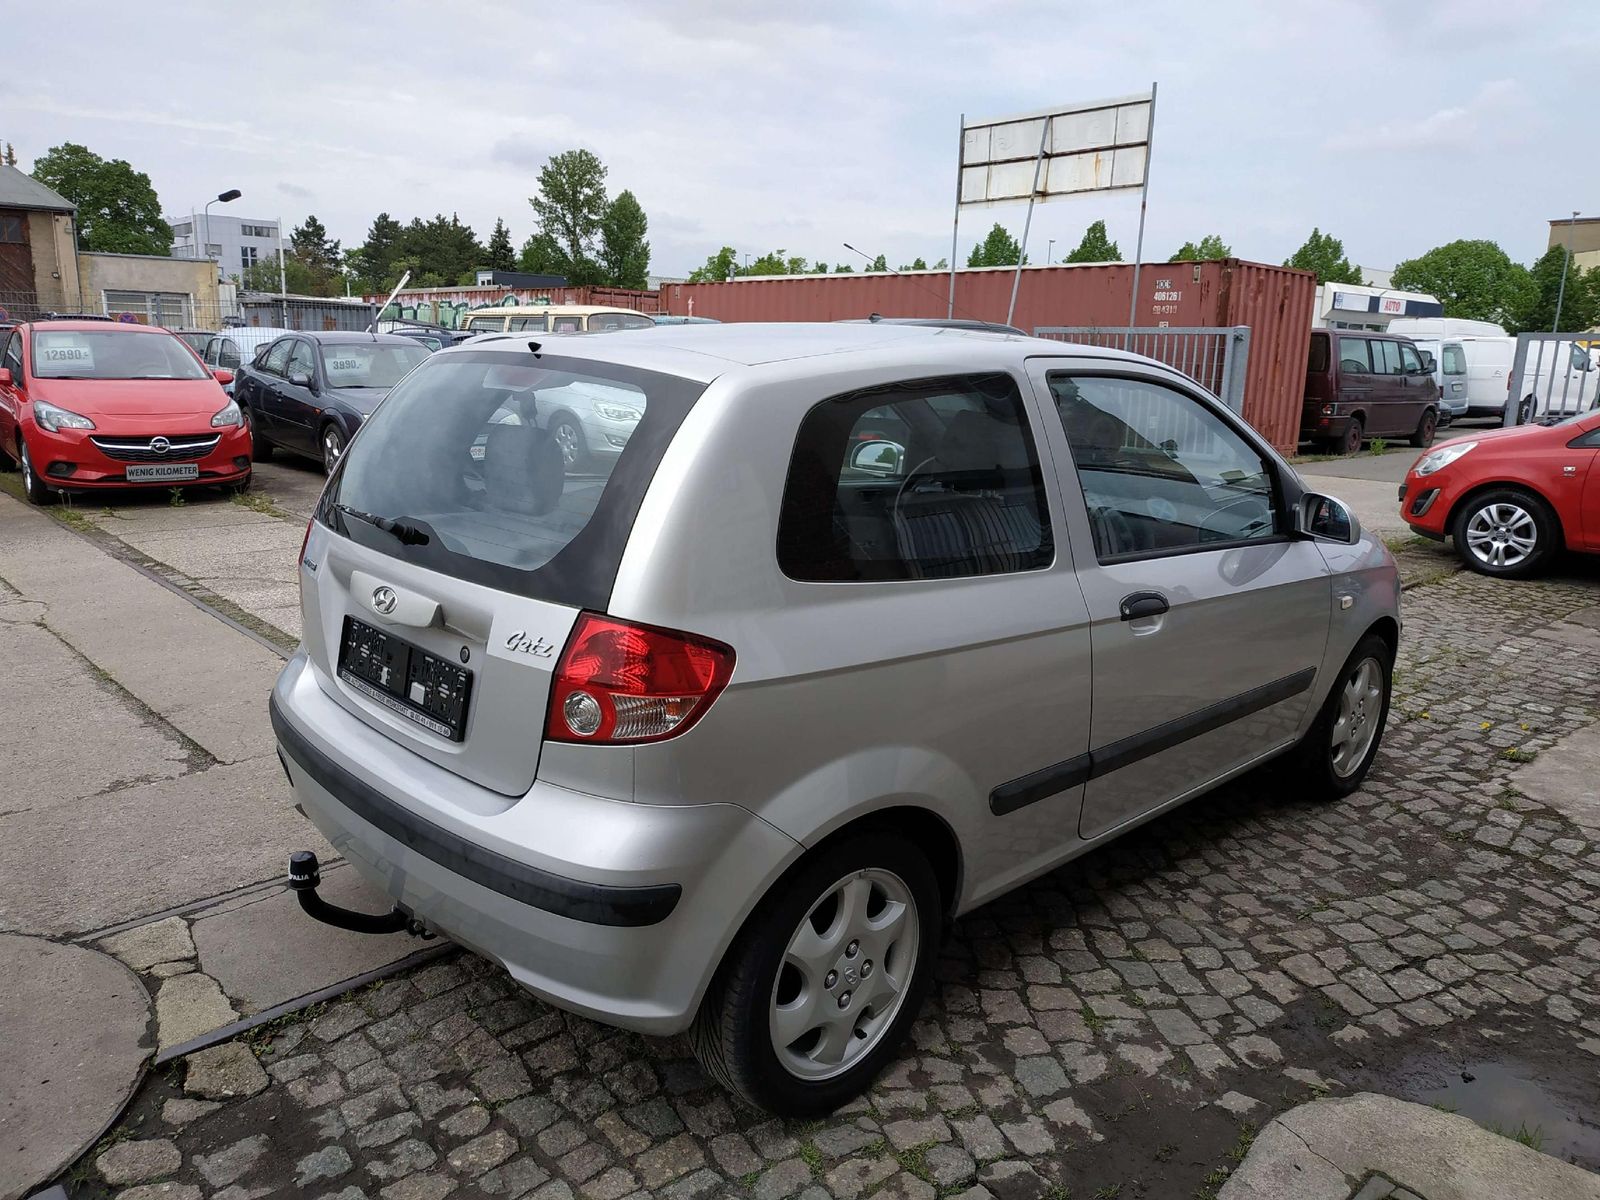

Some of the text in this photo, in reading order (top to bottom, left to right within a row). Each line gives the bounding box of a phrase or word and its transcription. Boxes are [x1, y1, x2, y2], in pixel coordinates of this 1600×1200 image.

[1384, 300, 1401, 312] AUTO
[128, 466, 198, 477] WENIG KILOMETER
[504, 630, 554, 658] Getz
